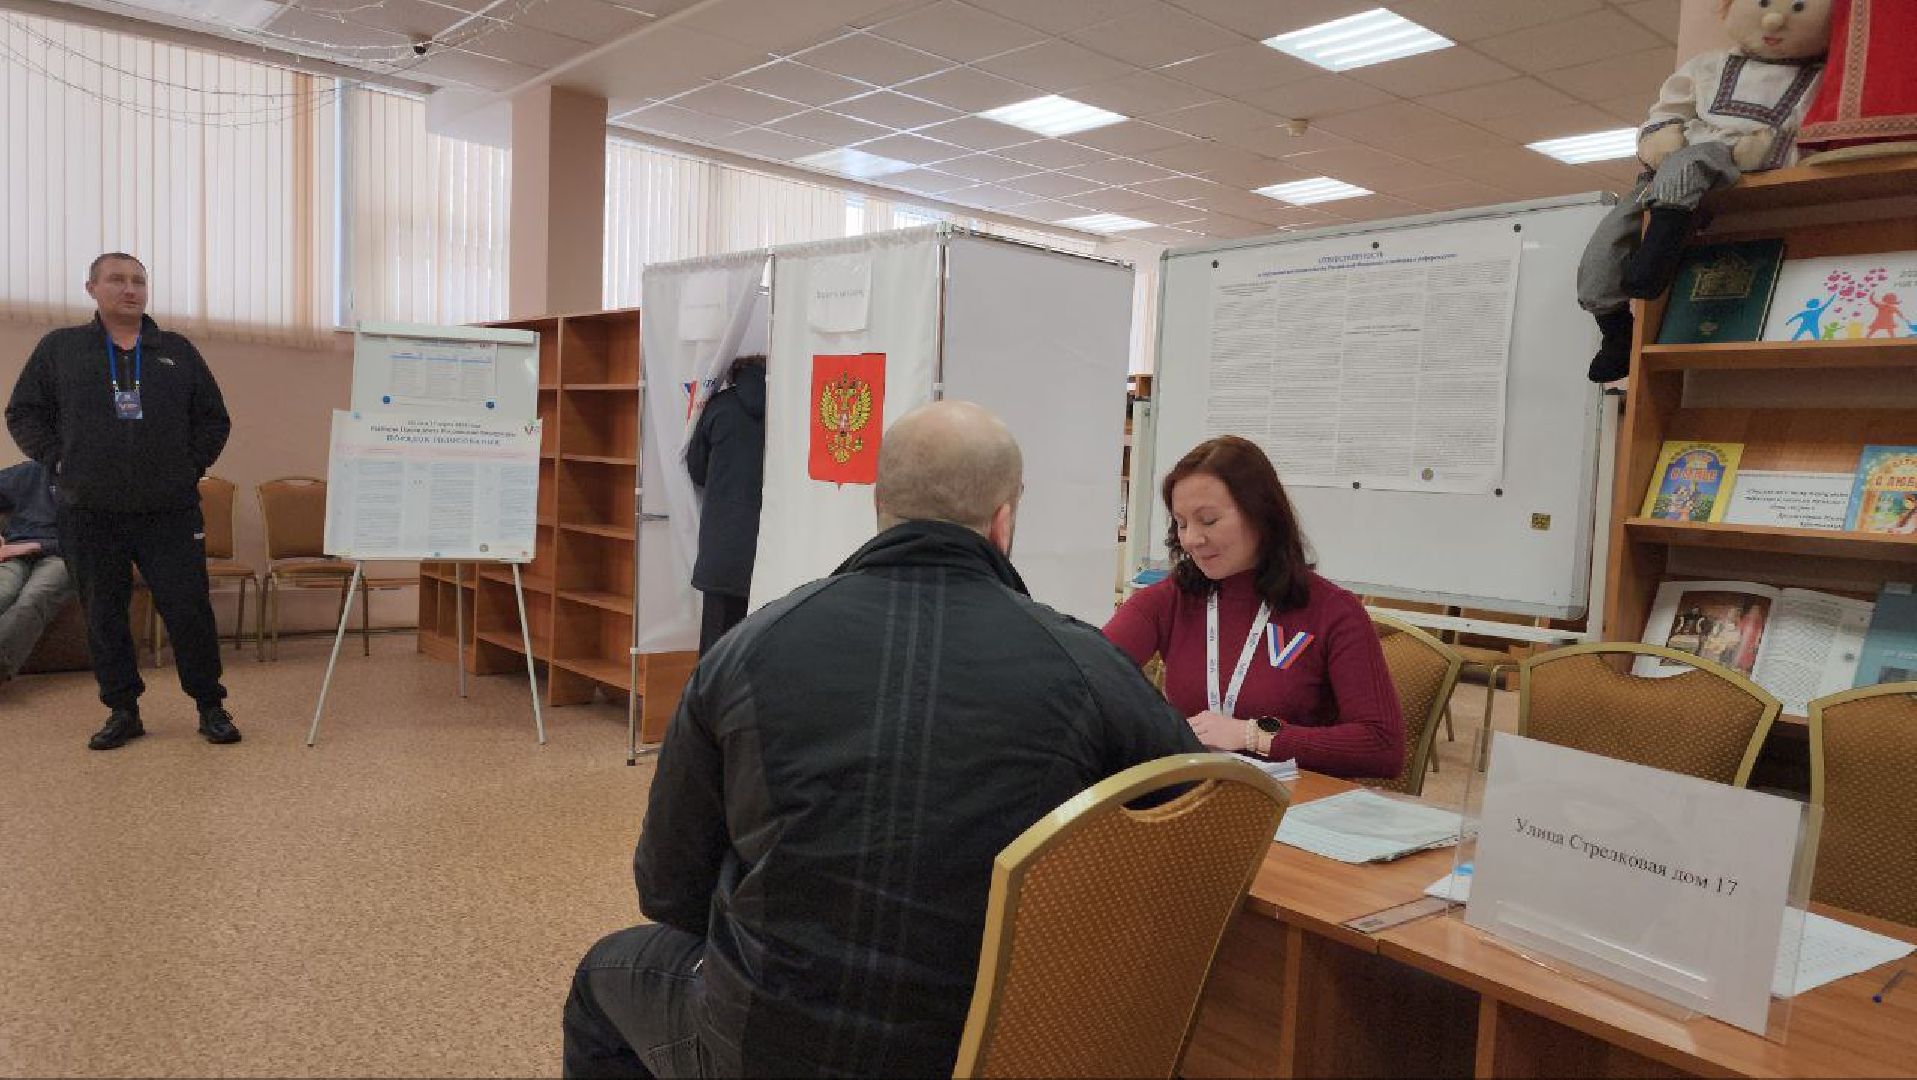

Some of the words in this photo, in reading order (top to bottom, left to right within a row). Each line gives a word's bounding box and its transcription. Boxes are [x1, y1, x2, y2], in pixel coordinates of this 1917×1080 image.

[1516, 818, 1564, 845] Улица
[1569, 834, 1667, 877] Стрелковая
[1671, 869, 1708, 889] дом
[1716, 877, 1738, 896] 17
